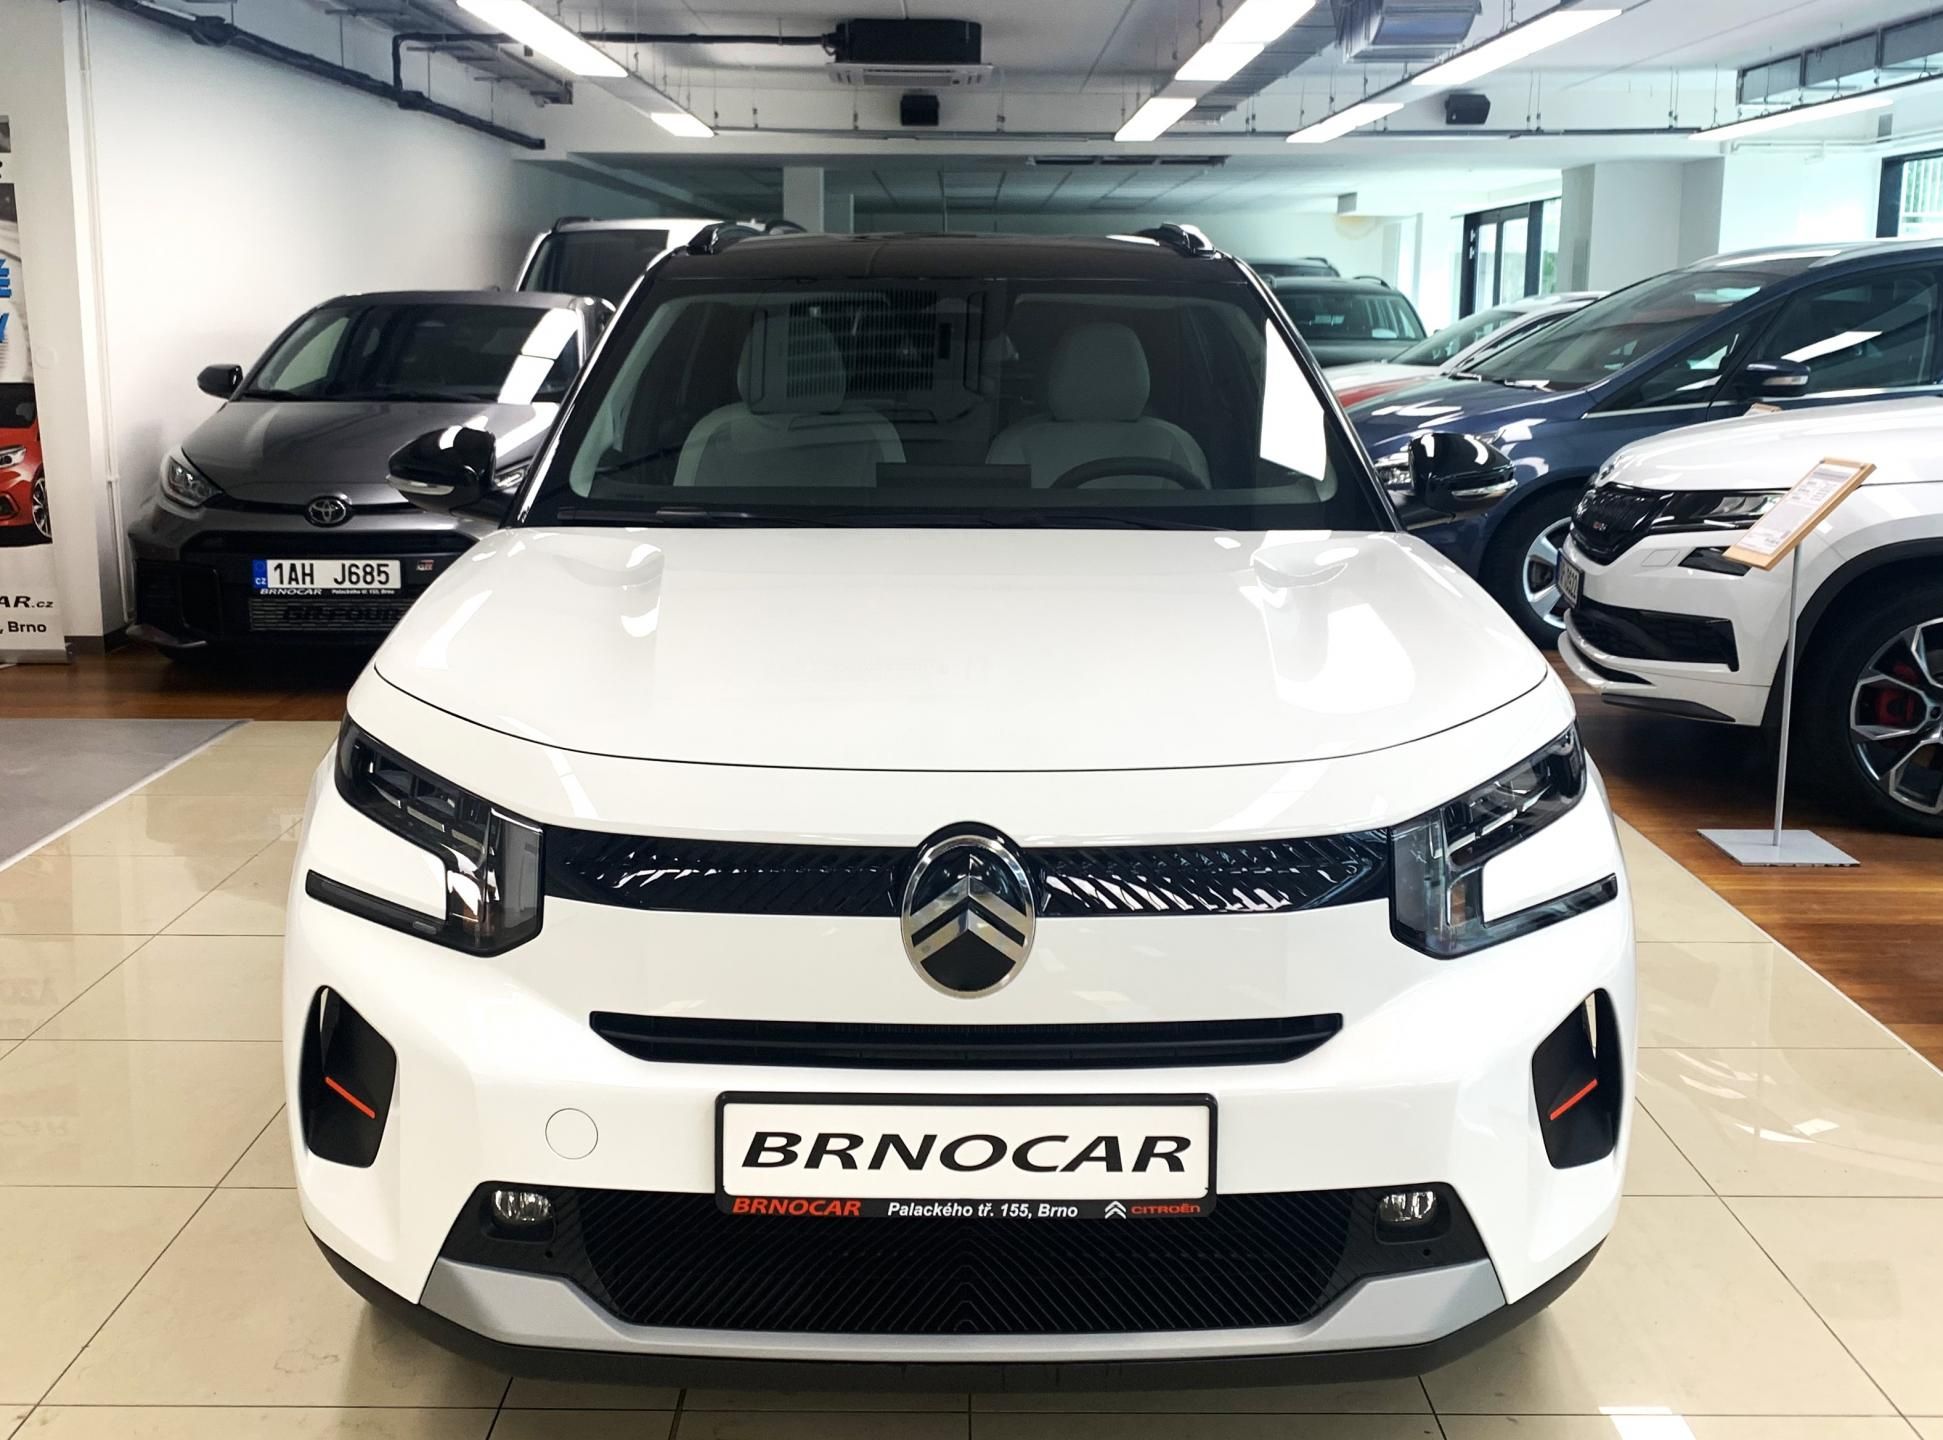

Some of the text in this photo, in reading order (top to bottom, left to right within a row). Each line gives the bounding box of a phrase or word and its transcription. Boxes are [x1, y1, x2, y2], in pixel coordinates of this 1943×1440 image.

[255, 577, 266, 585] CZ
[274, 562, 314, 585] 1AH
[333, 562, 390, 585] J685
[260, 587, 322, 596] BRNOCAR
[7, 621, 47, 633] Brno
[741, 1131, 1192, 1173] BRNOCAR
[732, 1197, 862, 1216] BRNOCAR
[887, 1201, 973, 1217] Palackého
[978, 1203, 994, 1217] tř.
[1000, 1203, 1033, 1219] 155,
[1037, 1203, 1079, 1218] Brno
